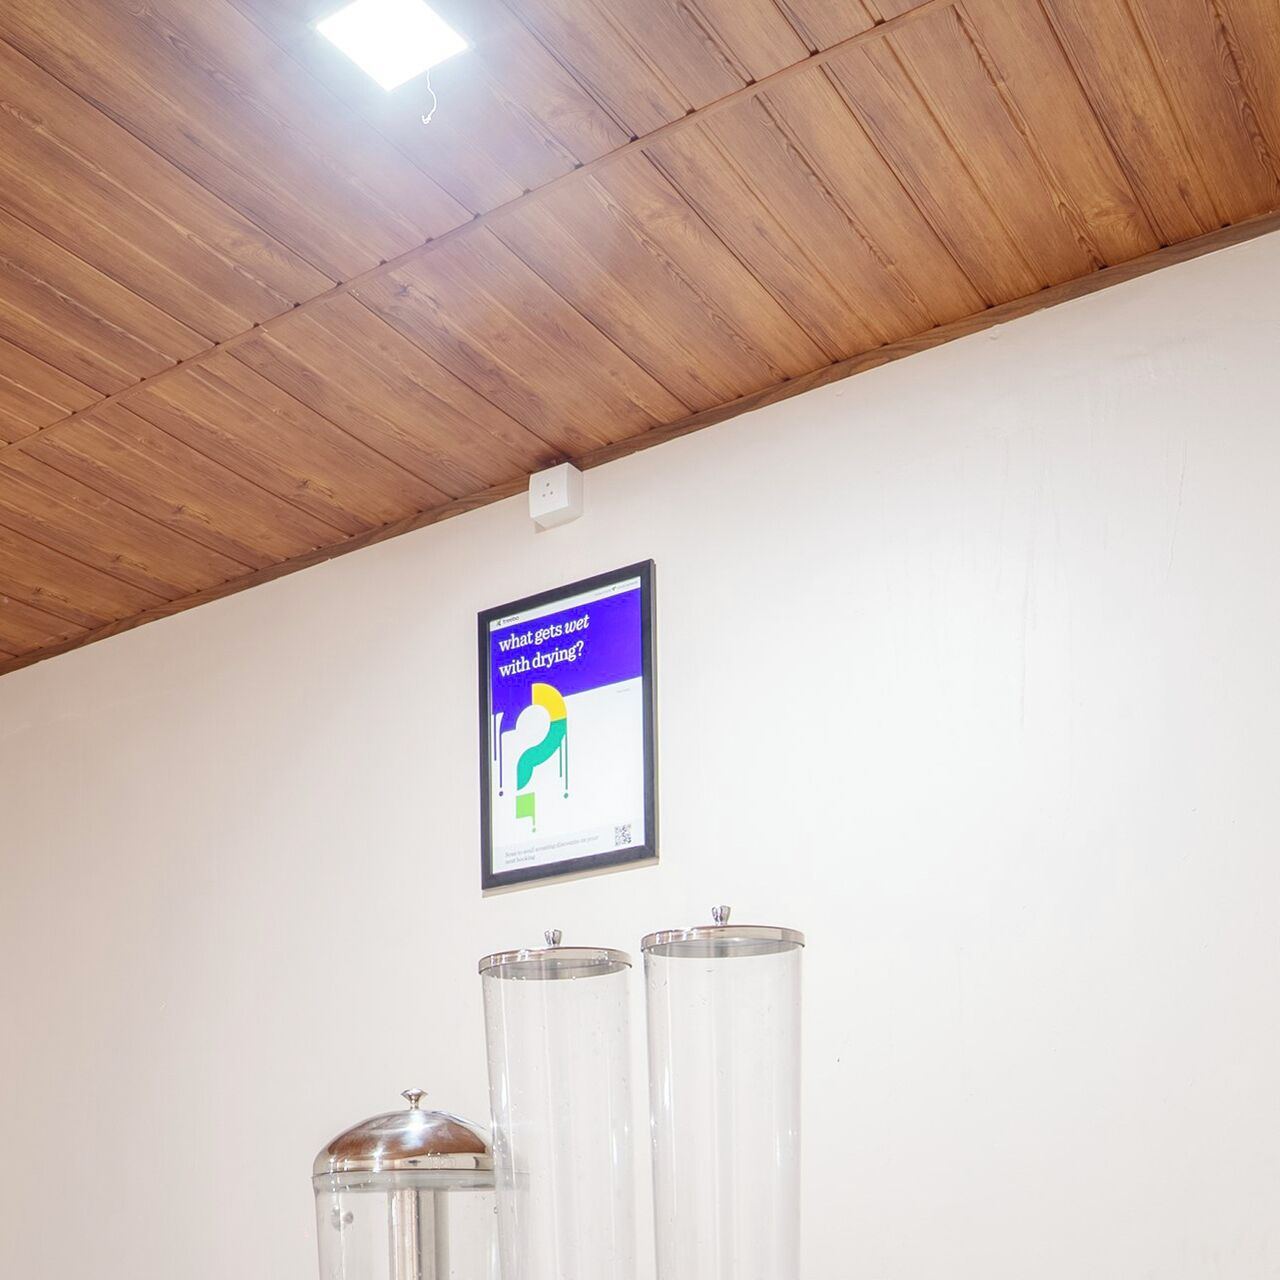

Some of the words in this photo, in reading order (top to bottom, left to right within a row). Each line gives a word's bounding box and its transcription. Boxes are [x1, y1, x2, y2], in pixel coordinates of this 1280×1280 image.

[499, 633, 533, 652] what
[534, 624, 563, 645] gets
[564, 614, 590, 634] wet
[499, 657, 531, 677] with
[532, 640, 584, 668] drying?
